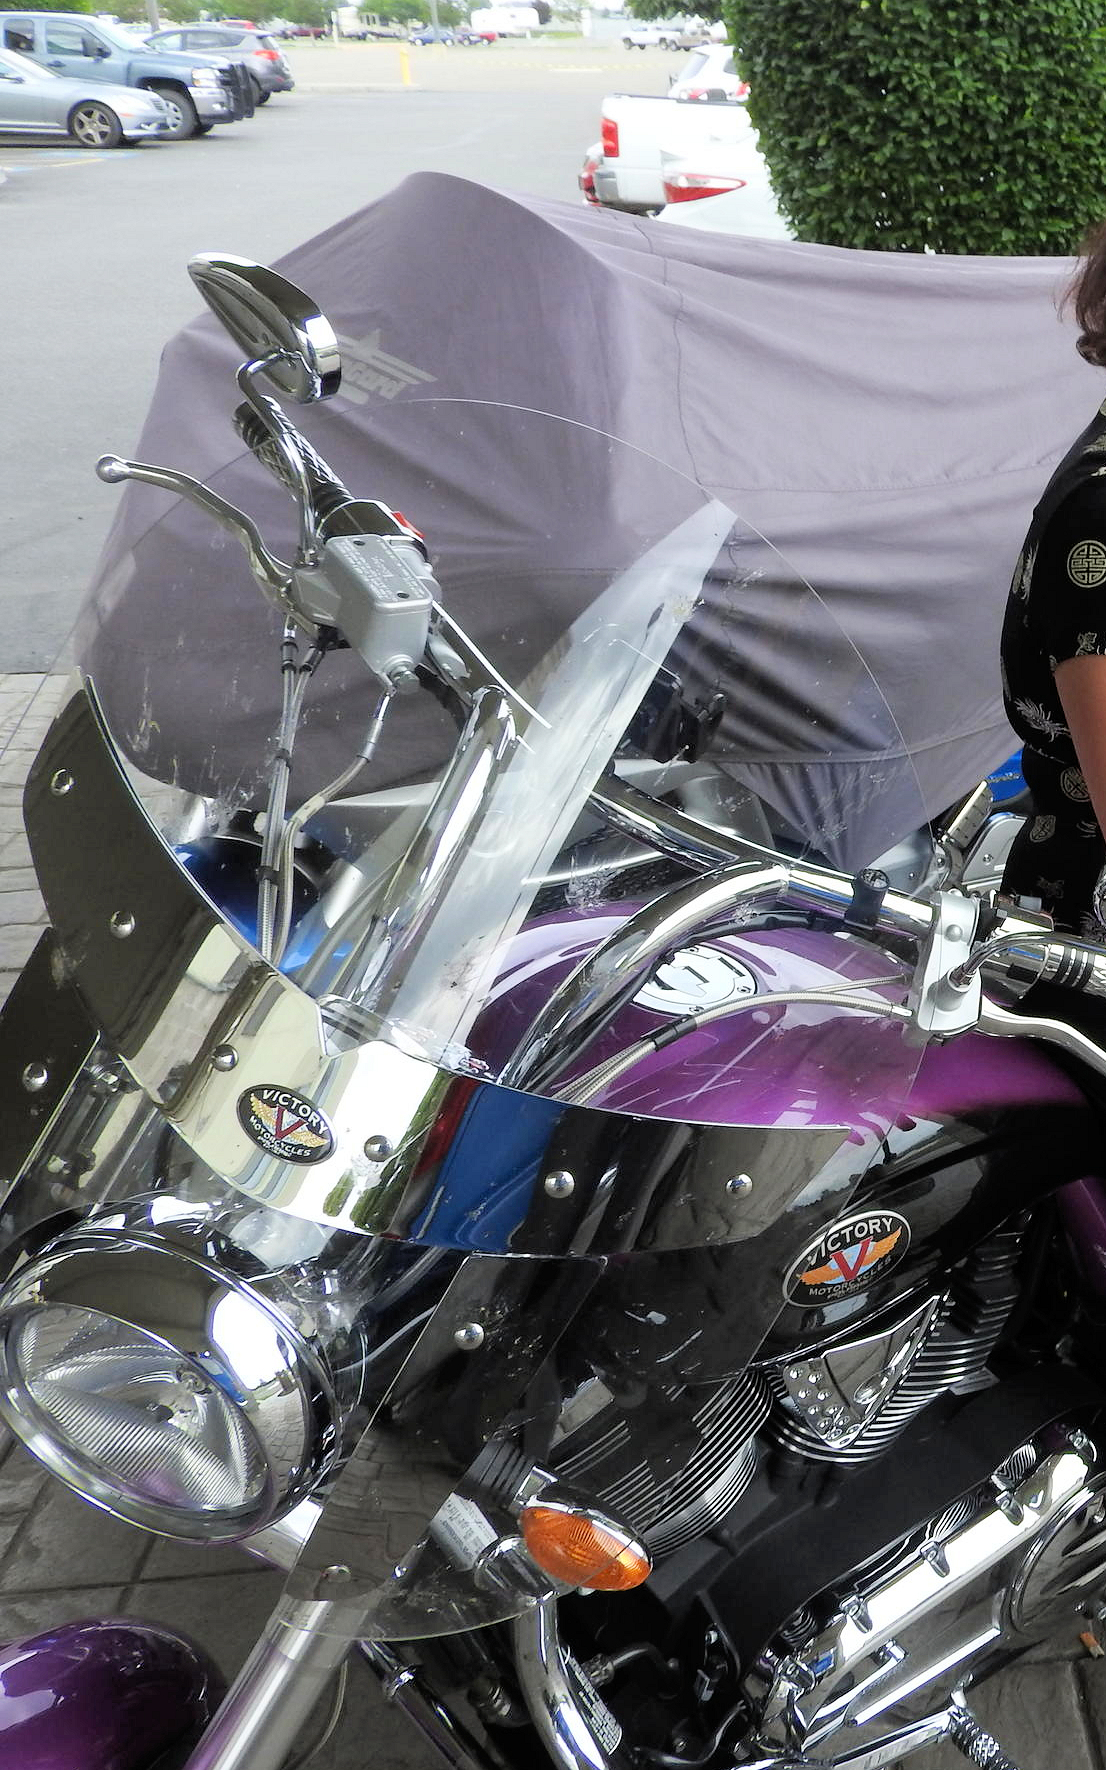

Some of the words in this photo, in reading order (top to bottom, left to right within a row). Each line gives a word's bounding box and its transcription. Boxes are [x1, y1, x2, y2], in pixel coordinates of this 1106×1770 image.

[263, 1089, 328, 1134] VICTORY
[249, 1115, 311, 1157] MOTORCYCLES
[807, 1217, 893, 1266] VICTORY
